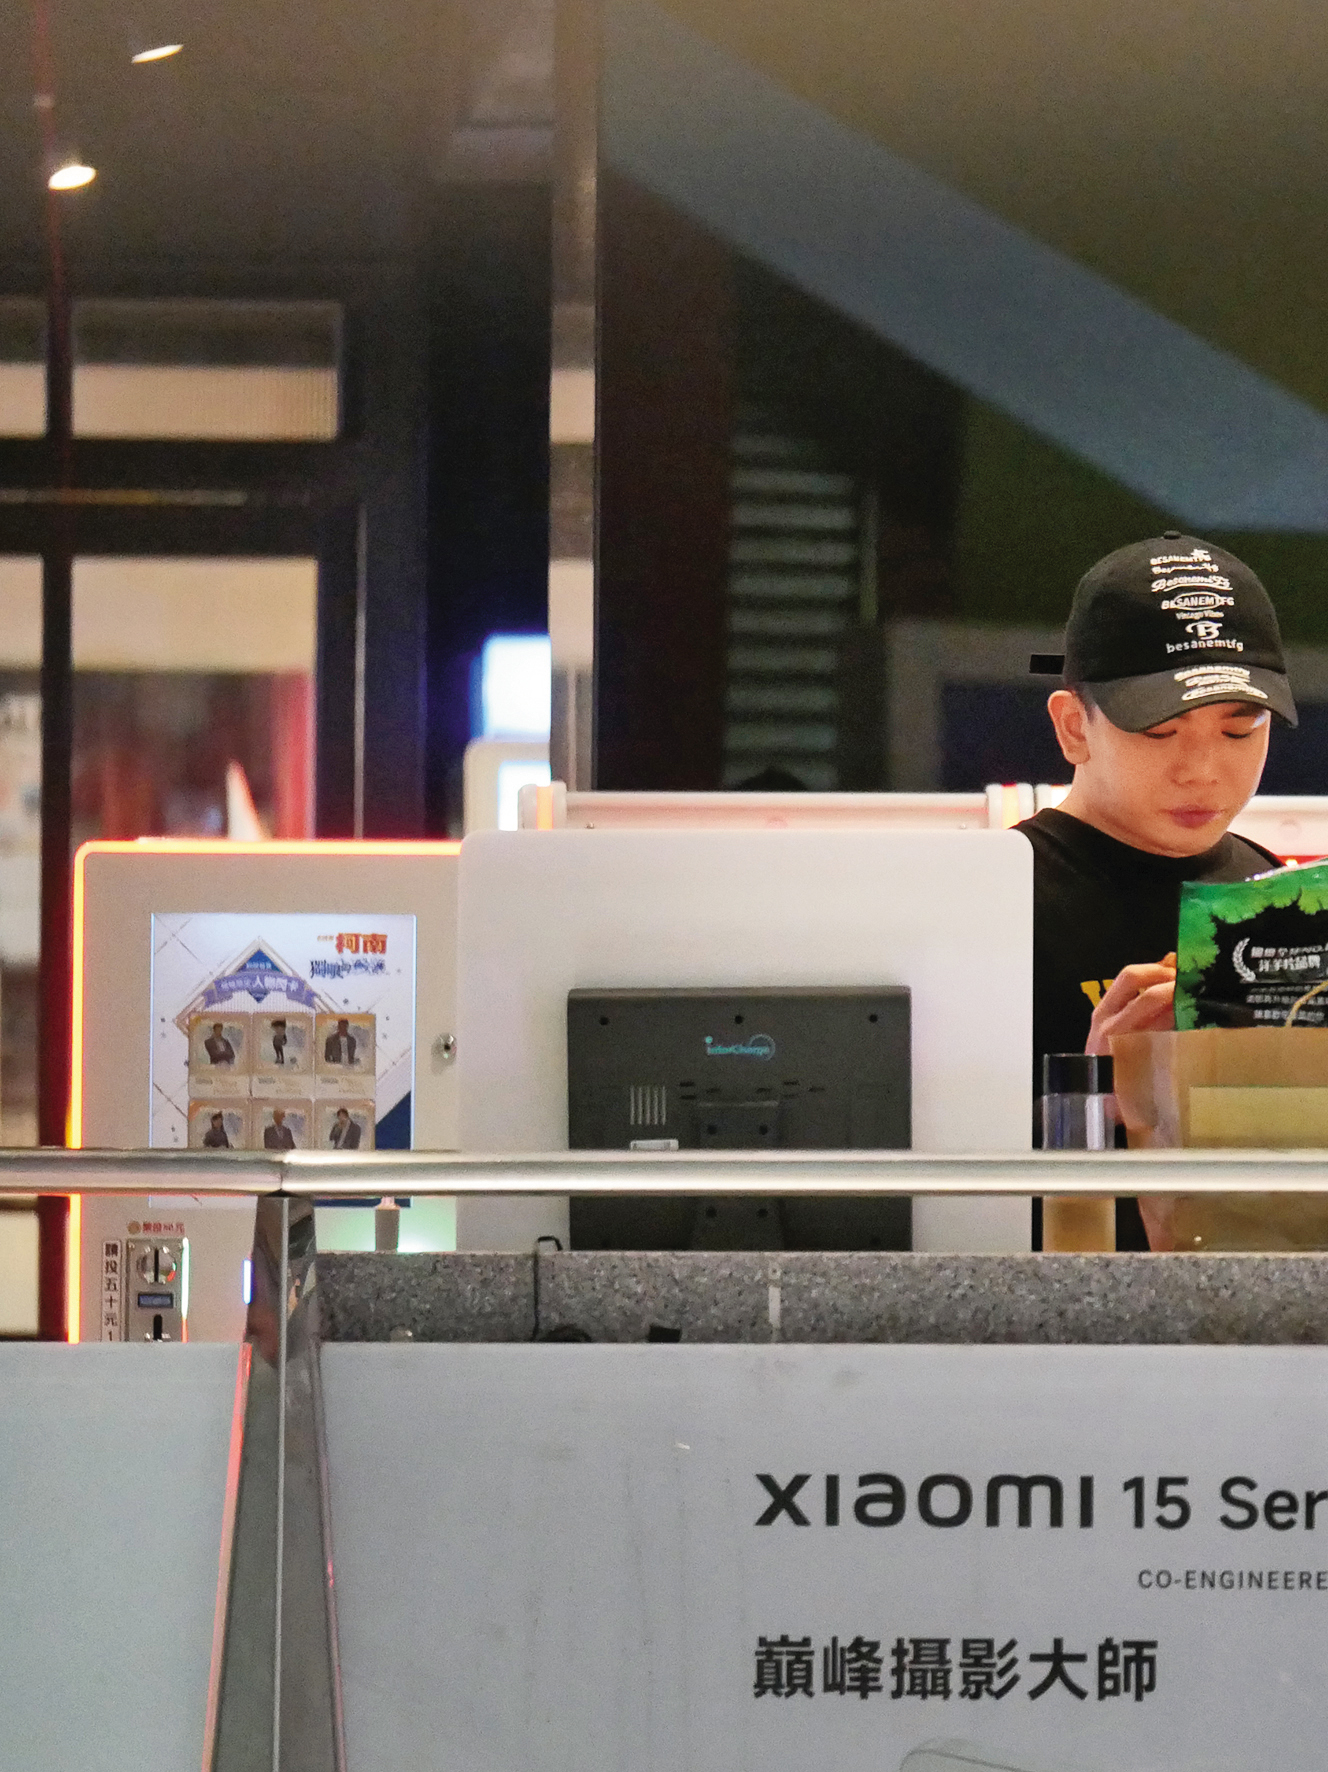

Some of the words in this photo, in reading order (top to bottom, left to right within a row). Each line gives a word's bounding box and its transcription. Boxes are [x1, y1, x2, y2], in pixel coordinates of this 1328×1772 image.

[1166, 639, 1244, 653] besanemtfg
[1122, 1476, 1192, 1530] 15
[753, 1635, 1159, 1702] 巔峰攝影大師
